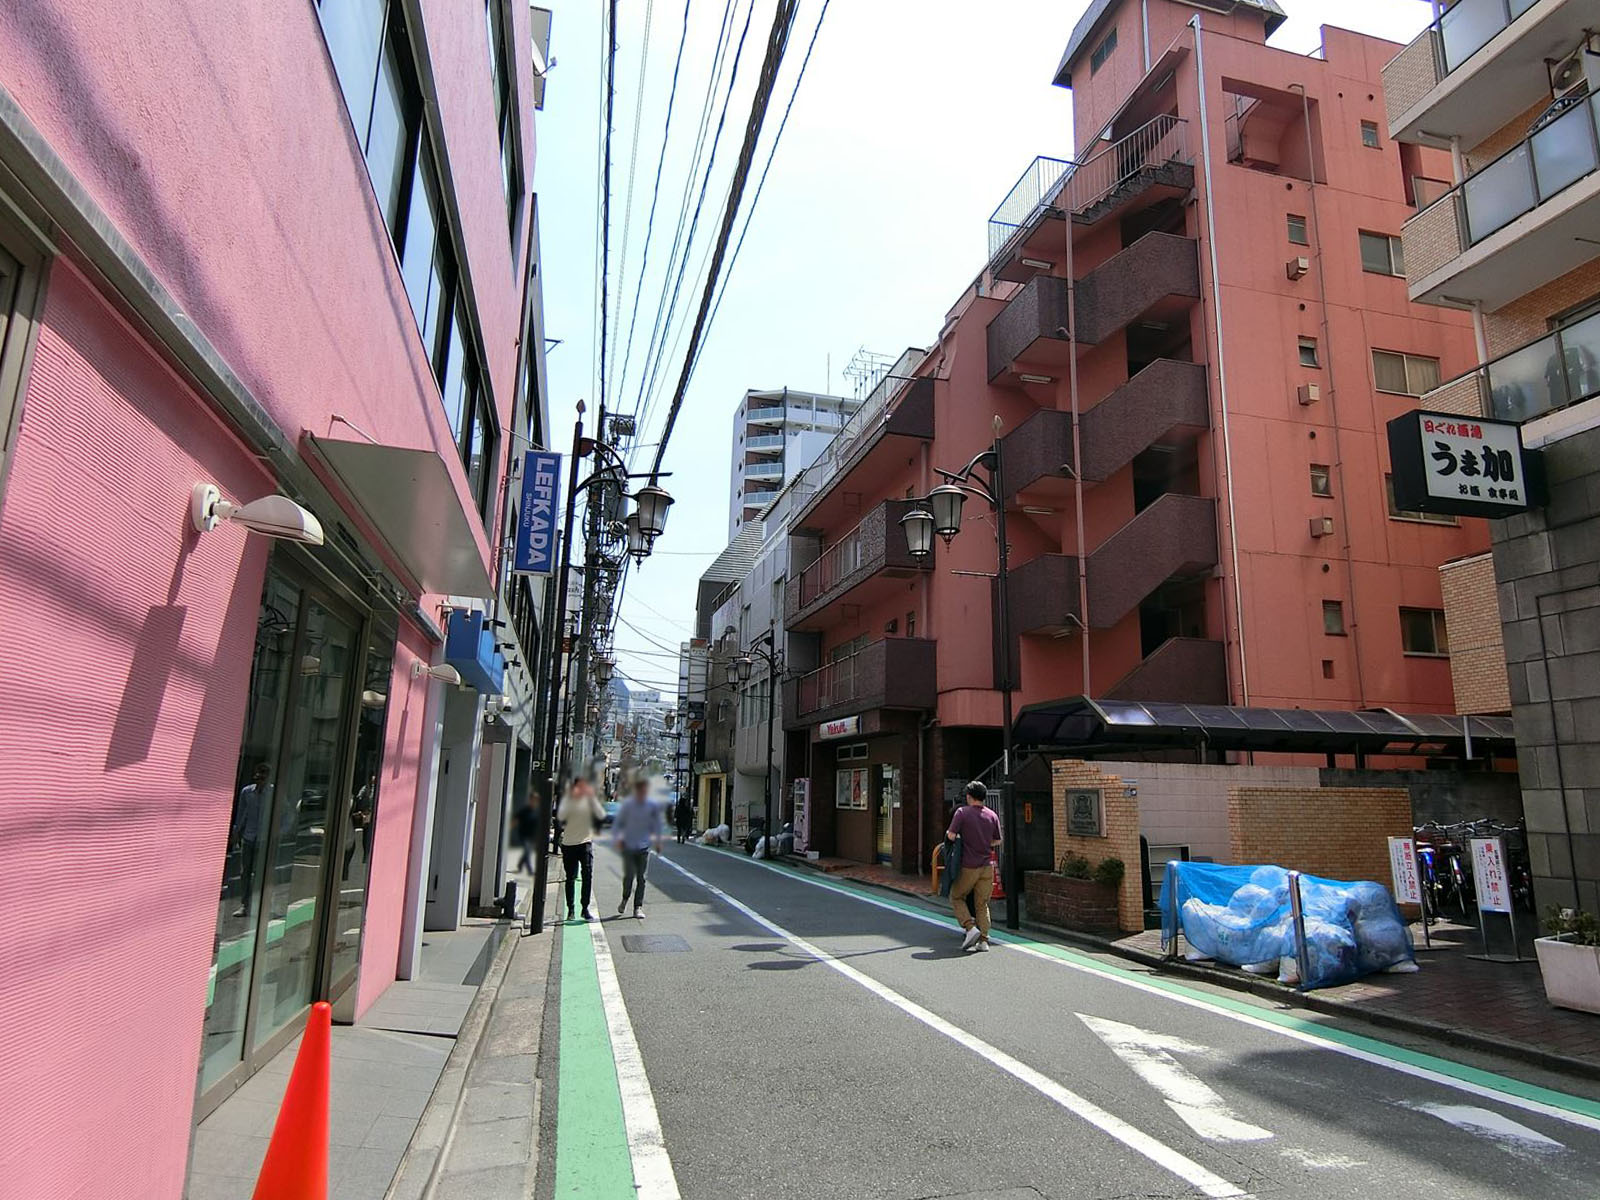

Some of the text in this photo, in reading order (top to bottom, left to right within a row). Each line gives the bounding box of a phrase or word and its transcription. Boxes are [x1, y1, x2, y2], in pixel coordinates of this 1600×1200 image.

[1431, 440, 1514, 483] うま加
[523, 492, 533, 528] SHINJUKU
[527, 457, 555, 565] LEFKADA
